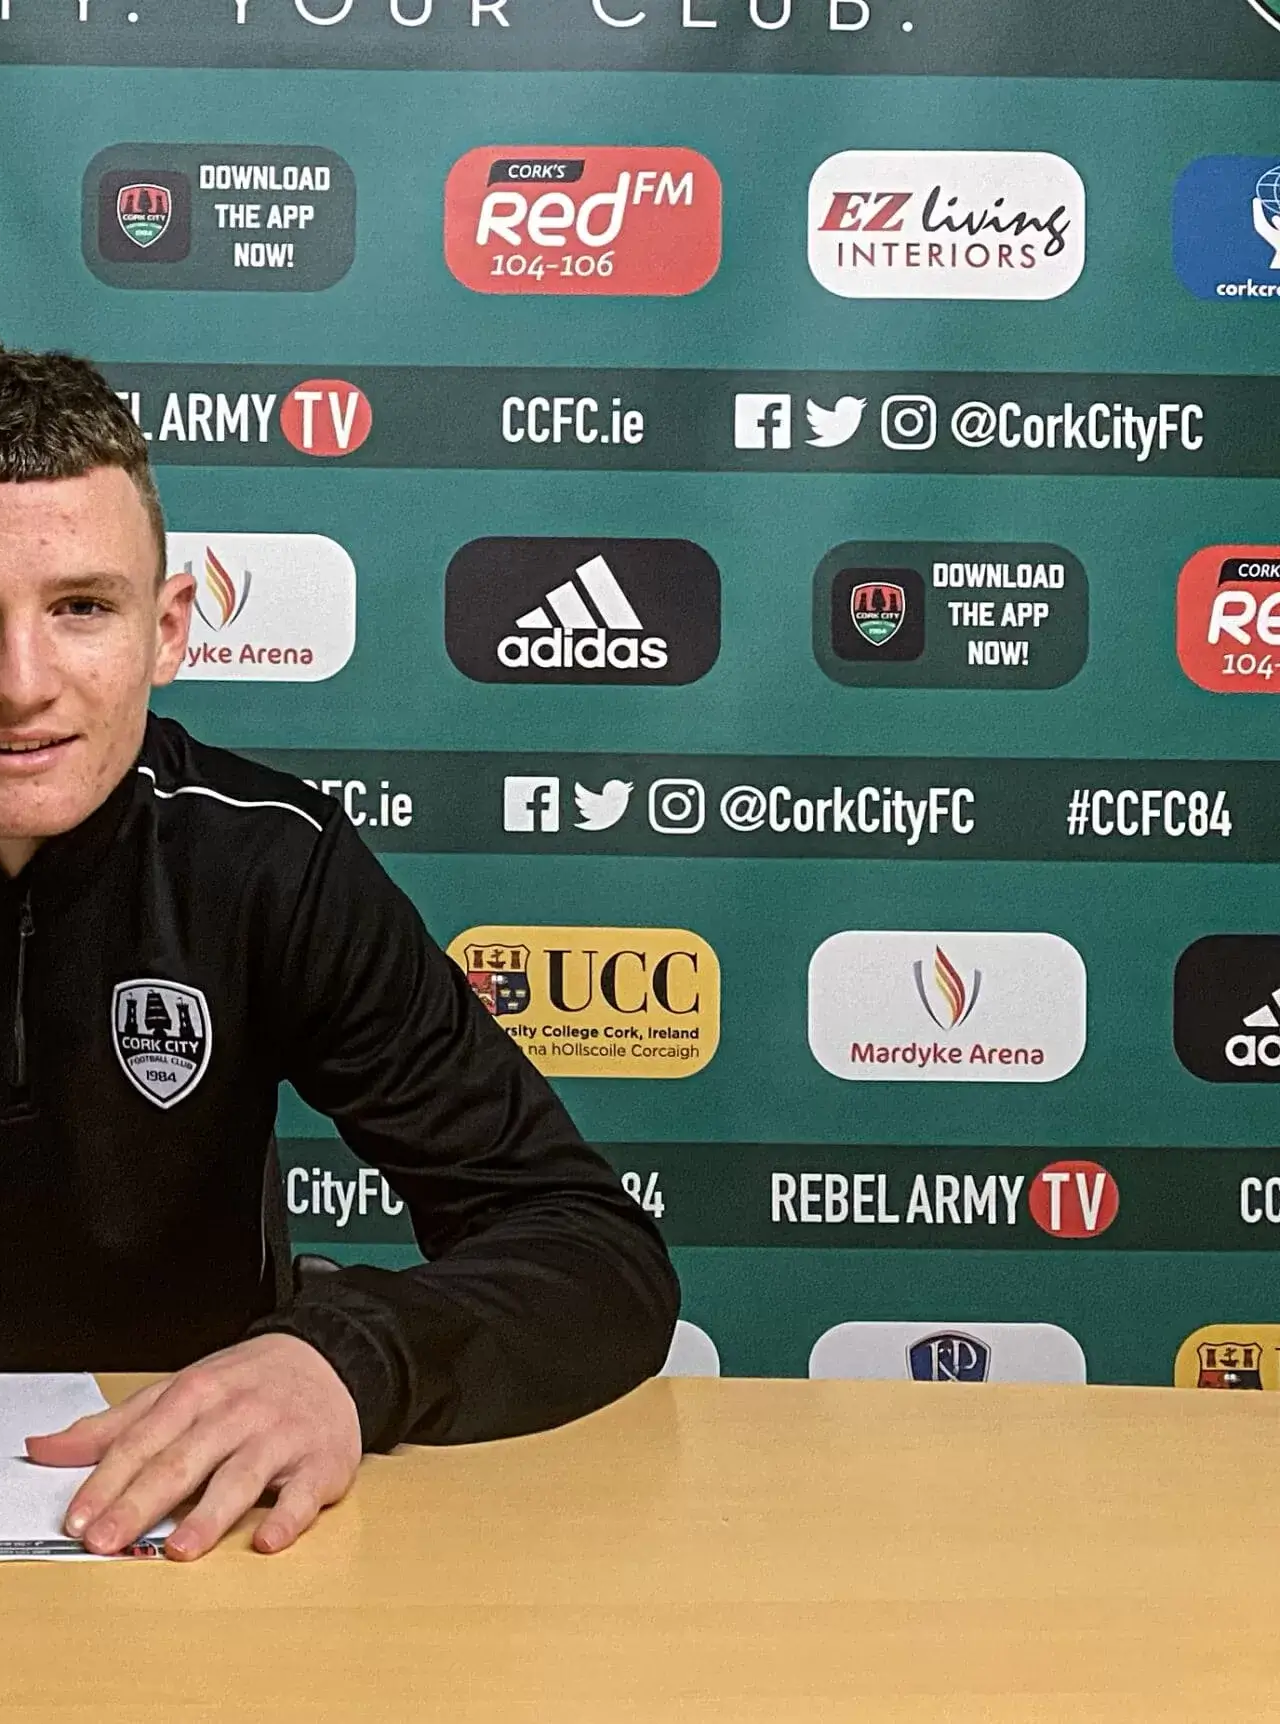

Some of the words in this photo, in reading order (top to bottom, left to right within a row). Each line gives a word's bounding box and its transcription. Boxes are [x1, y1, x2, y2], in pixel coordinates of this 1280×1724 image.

[199, 165, 331, 191] DOWNLOAD
[508, 163, 567, 179] CORK'S
[214, 203, 261, 229] THE
[266, 204, 314, 229] APP
[475, 171, 631, 247] Red
[631, 171, 695, 206] FM
[817, 191, 914, 232] EZ
[921, 185, 1072, 257] living
[234, 242, 294, 268] NOW!
[490, 251, 616, 281] 104-106
[837, 242, 1037, 269] INTERIORS
[158, 392, 277, 443] ARMY
[294, 391, 359, 449] TV
[502, 396, 644, 444] CCFC.ie
[950, 401, 1203, 462] @CorkCityFC
[933, 562, 1065, 589] DOWNLOAD
[1238, 563, 1280, 578] CORK
[947, 601, 995, 627] THE
[1000, 602, 1049, 627] APP
[239, 643, 313, 661] Arena
[496, 627, 668, 669] adidas
[968, 640, 1029, 666] NOW!
[302, 779, 413, 827] C.ie
[719, 785, 975, 846] @CorkCityFC
[1066, 789, 1232, 837] #CCFC84
[543, 949, 700, 1015] UCC
[122, 1036, 161, 1052] CORK
[165, 1040, 200, 1054] CITY
[505, 1024, 537, 1039] rsity
[541, 1025, 599, 1040] College
[603, 1026, 643, 1041] Cork,
[648, 1026, 699, 1040] Ireland
[129, 1055, 169, 1066] FOOTBALL
[528, 1045, 547, 1056] na
[551, 1042, 626, 1057] hOllscoile
[631, 1043, 700, 1060] Corcaigh
[851, 1042, 962, 1068] Mardyke
[969, 1043, 1044, 1065] Arena
[146, 1070, 177, 1083] 1984
[287, 1167, 404, 1227] CityFC
[771, 1173, 900, 1224] REBEL
[905, 1174, 1024, 1225] ARMY
[1042, 1172, 1107, 1231] TV
